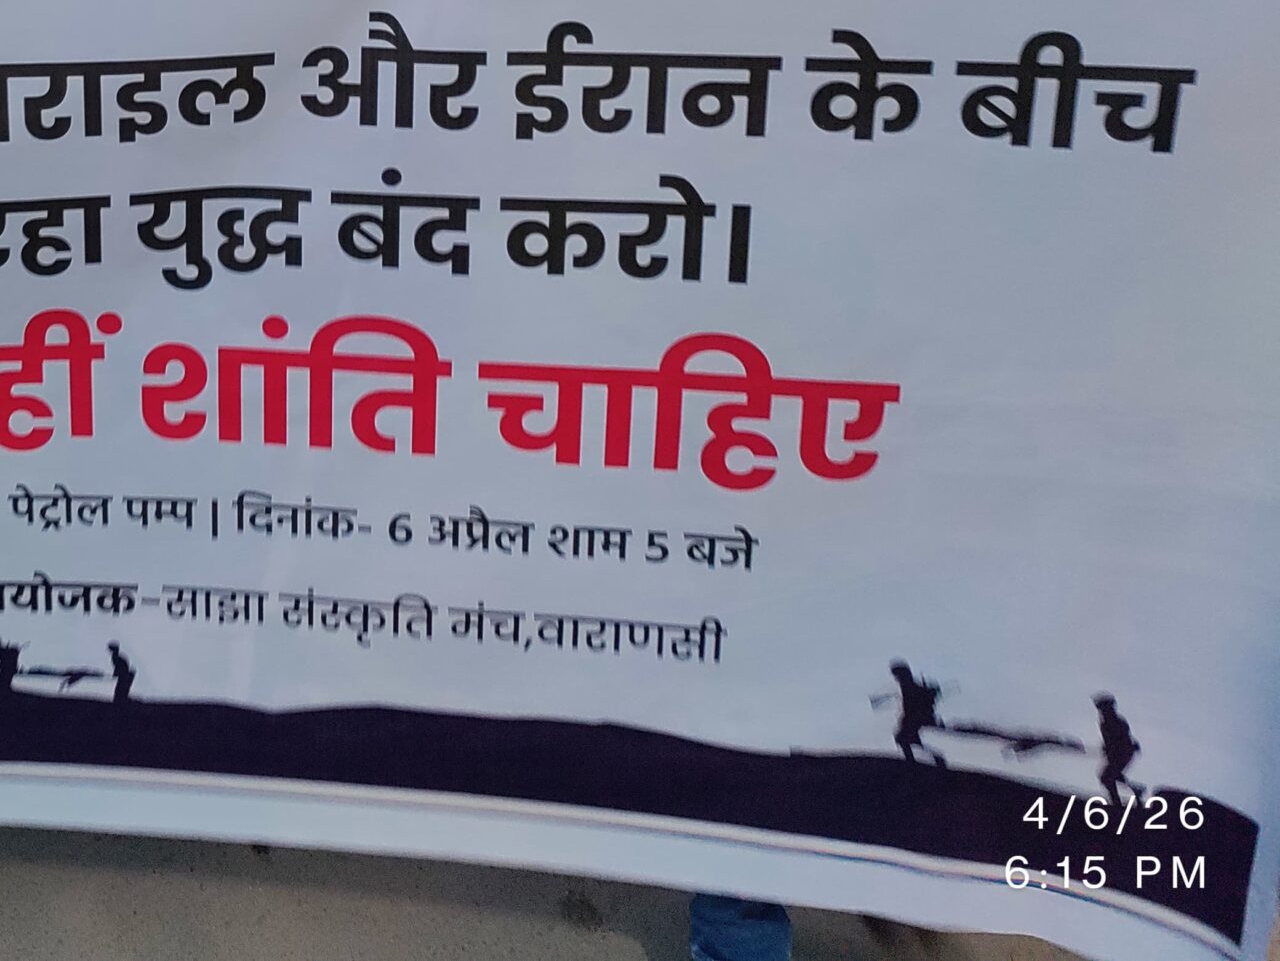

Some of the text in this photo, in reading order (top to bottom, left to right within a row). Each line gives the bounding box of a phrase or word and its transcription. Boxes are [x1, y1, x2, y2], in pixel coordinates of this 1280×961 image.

[300, 11, 488, 131] और
[507, 21, 783, 140] ईरान
[804, 28, 934, 141] के
[956, 30, 1198, 154] बीच
[129, 186, 312, 291] युद्ध
[330, 167, 481, 276] बंद
[500, 174, 752, 285] करो।
[140, 313, 453, 457] शांति
[478, 331, 901, 491] चाहिए
[8, 482, 113, 531] पेट्रोल
[122, 495, 198, 531] पम्प
[233, 490, 371, 541] दिनांक-
[387, 513, 414, 546] 6
[428, 505, 535, 557] अप्रैल
[547, 523, 633, 562] शाम
[645, 530, 669, 564] 5
[684, 526, 760, 571] बजे
[278, 587, 437, 648] संस्कृति
